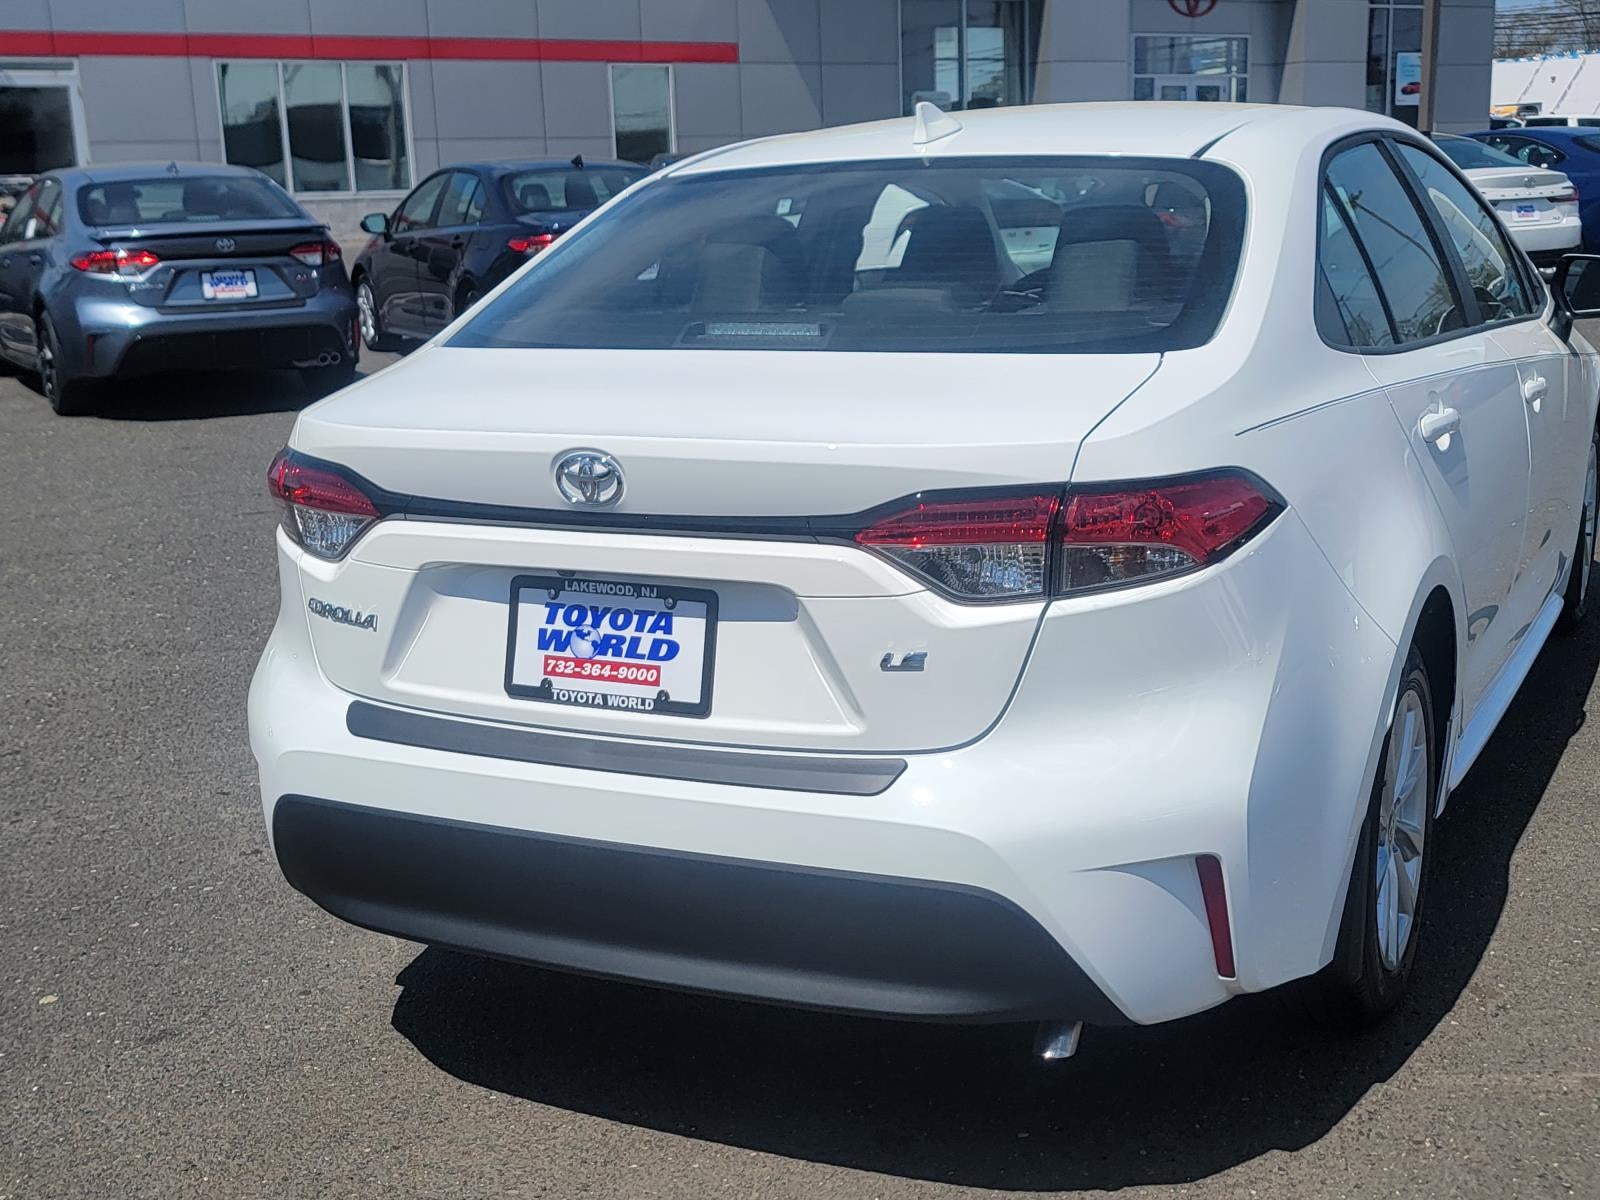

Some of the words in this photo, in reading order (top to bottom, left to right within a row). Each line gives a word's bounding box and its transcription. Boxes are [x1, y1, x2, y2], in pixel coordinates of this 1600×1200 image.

[564, 580, 638, 598] LAKEWOOD,
[641, 586, 658, 598] NJ
[545, 602, 673, 635] TOYOTA
[537, 624, 680, 661] WORLD
[546, 659, 658, 682] 732-364-9000
[880, 652, 928, 672] LE
[552, 688, 604, 706] TOYOTA
[607, 694, 655, 711] WORLD
